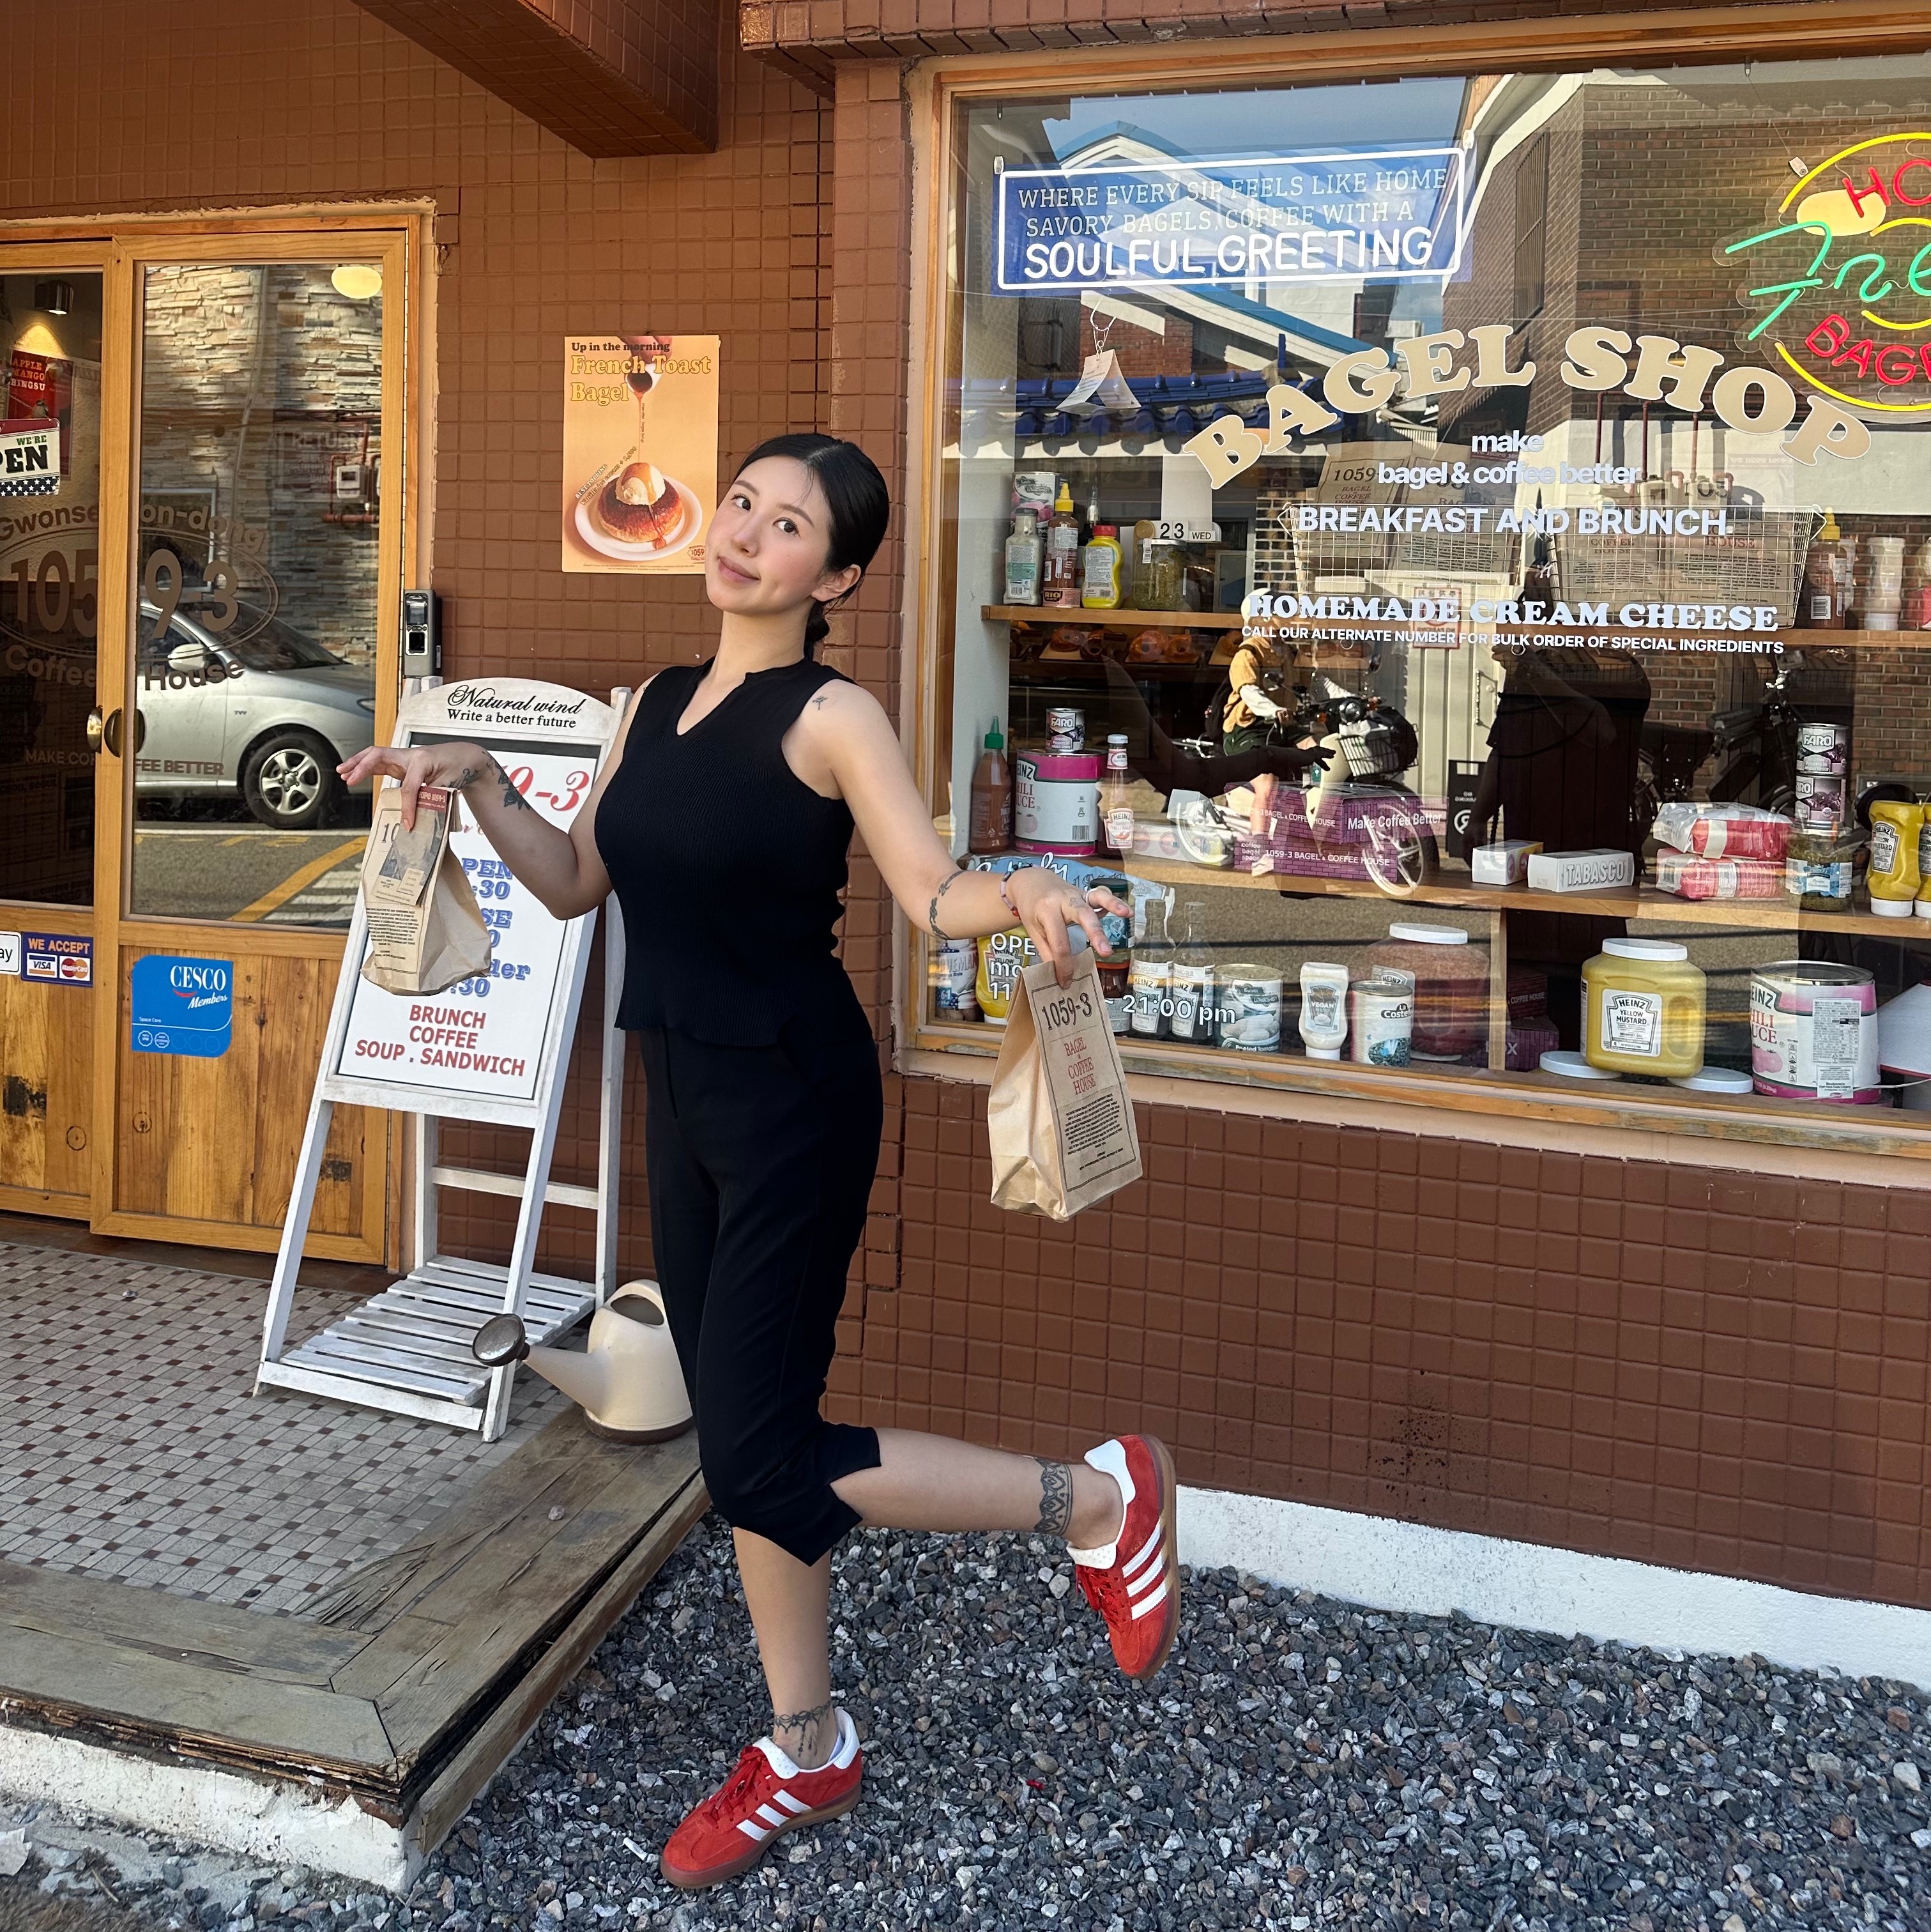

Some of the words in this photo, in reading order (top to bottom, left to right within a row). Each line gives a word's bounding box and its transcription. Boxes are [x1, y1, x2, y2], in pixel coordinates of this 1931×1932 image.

[1019, 188, 1097, 209] WHERE
[1106, 183, 1178, 206] EVERY
[1187, 181, 1222, 201] SIP
[1231, 176, 1302, 198] FEELS
[1312, 172, 1366, 195] LIKE
[1377, 168, 1447, 191] HOME
[1026, 216, 1111, 237] SAVORY
[1226, 207, 1313, 230] COFFEE
[1323, 203, 1385, 225] WITH
[1395, 201, 1412, 221] A
[1024, 239, 1205, 279] SOULFUL
[1218, 228, 1432, 273] GREETING
[571, 342, 587, 353] Up
[589, 342, 600, 351] in
[602, 342, 621, 351] the
[623, 342, 671, 353] morning
[13, 358, 42, 370] APPLE
[570, 355, 646, 374] French
[652, 355, 711, 374] Toast
[10, 378, 45, 390] BINGSU
[13, 368, 45, 381] MANGO
[570, 381, 629, 406] Bagel
[1183, 325, 1536, 490] BAGEL
[1560, 326, 1872, 466] SHOP
[17, 435, 47, 445] WE'RE
[1472, 430, 1544, 452] make
[0, 445, 48, 473] EN
[1378, 462, 1447, 489] bagel
[1451, 462, 1470, 484] &
[1474, 461, 1556, 484] coffee
[1560, 461, 1641, 484] better
[1299, 507, 1488, 533] BREAKFAST
[1495, 508, 1569, 534] AND
[1160, 523, 1184, 539] 23
[691, 548, 705, 556] 1059
[1706, 537, 1755, 549] HOUSE
[1248, 594, 1460, 622] HOMEMADE
[1470, 599, 1610, 626] CREAM
[1619, 604, 1778, 631] CHEESE
[1242, 626, 1276, 638] CALL
[1279, 626, 1309, 639] OUR
[1311, 629, 1391, 641] ALTERNATE
[1394, 631, 1456, 643] NUMBER
[1459, 632, 1488, 644] FOR
[1492, 634, 1530, 646] BULK
[1533, 634, 1584, 647] ORDER
[1587, 636, 1608, 648] OF
[1611, 637, 1677, 650] SPECIAL
[1680, 639, 1784, 654] INGREDIENTS
[5, 645, 96, 687] Coffee
[145, 660, 243, 691] House
[448, 685, 537, 711] Natural
[534, 699, 586, 714] wind
[448, 709, 482, 723] Write
[496, 712, 535, 725] better
[537, 716, 576, 728] future
[1051, 717, 1073, 728] FARO
[1803, 735, 1832, 746] FARO
[26, 749, 63, 763] MAKE
[164, 760, 224, 775] BETTER
[1017, 763, 1033, 779] EINZ
[1017, 781, 1033, 795] HILI
[1796, 781, 1812, 793] ARO
[1017, 794, 1035, 808] UCE
[1264, 809, 1283, 818] BAGEL
[1289, 813, 1313, 824] COFFE
[1348, 816, 1375, 830] Make
[1378, 814, 1410, 829] Coffee
[1413, 813, 1442, 825] Better
[1265, 849, 1292, 858] 1059-3
[1294, 851, 1320, 861] BAGEL
[1327, 854, 1359, 863] COFFEE
[1361, 856, 1390, 866] HOUSE
[461, 858, 513, 880] PEN
[1567, 859, 1626, 887] TABASCO
[472, 880, 510, 900] :30
[28, 938, 45, 950] WE
[48, 940, 90, 954] ACCEPT
[991, 933, 1040, 956] OPE
[0, 948, 13, 963] ay
[33, 961, 51, 970] VISA
[170, 965, 226, 991] CESCO
[488, 959, 530, 981] der
[450, 978, 491, 997] :30
[1134, 977, 1154, 988] HEINZ
[1174, 981, 1189, 992] EINZ
[187, 992, 228, 1009] Members
[1511, 994, 1529, 1004] COFFEE
[1619, 999, 1645, 1009] HEINZ
[1751, 986, 1774, 1009] EINZ
[409, 1004, 486, 1029] BRUNCH
[1041, 992, 1092, 1031] 1059-3
[1122, 995, 1192, 1019] 21:00
[1200, 1006, 1236, 1025] pm
[1750, 1008, 1775, 1028] HILI
[1617, 1016, 1647, 1025] MUSTARD
[409, 1026, 478, 1049] COFFEE
[1752, 1023, 1777, 1045] UCE
[1064, 1037, 1087, 1057] BAGEL
[355, 1040, 405, 1061] SOUP
[420, 1048, 525, 1077] SANDWICH
[1068, 1057, 1094, 1079] COFFEE
[1073, 1073, 1096, 1095] HOUSE
